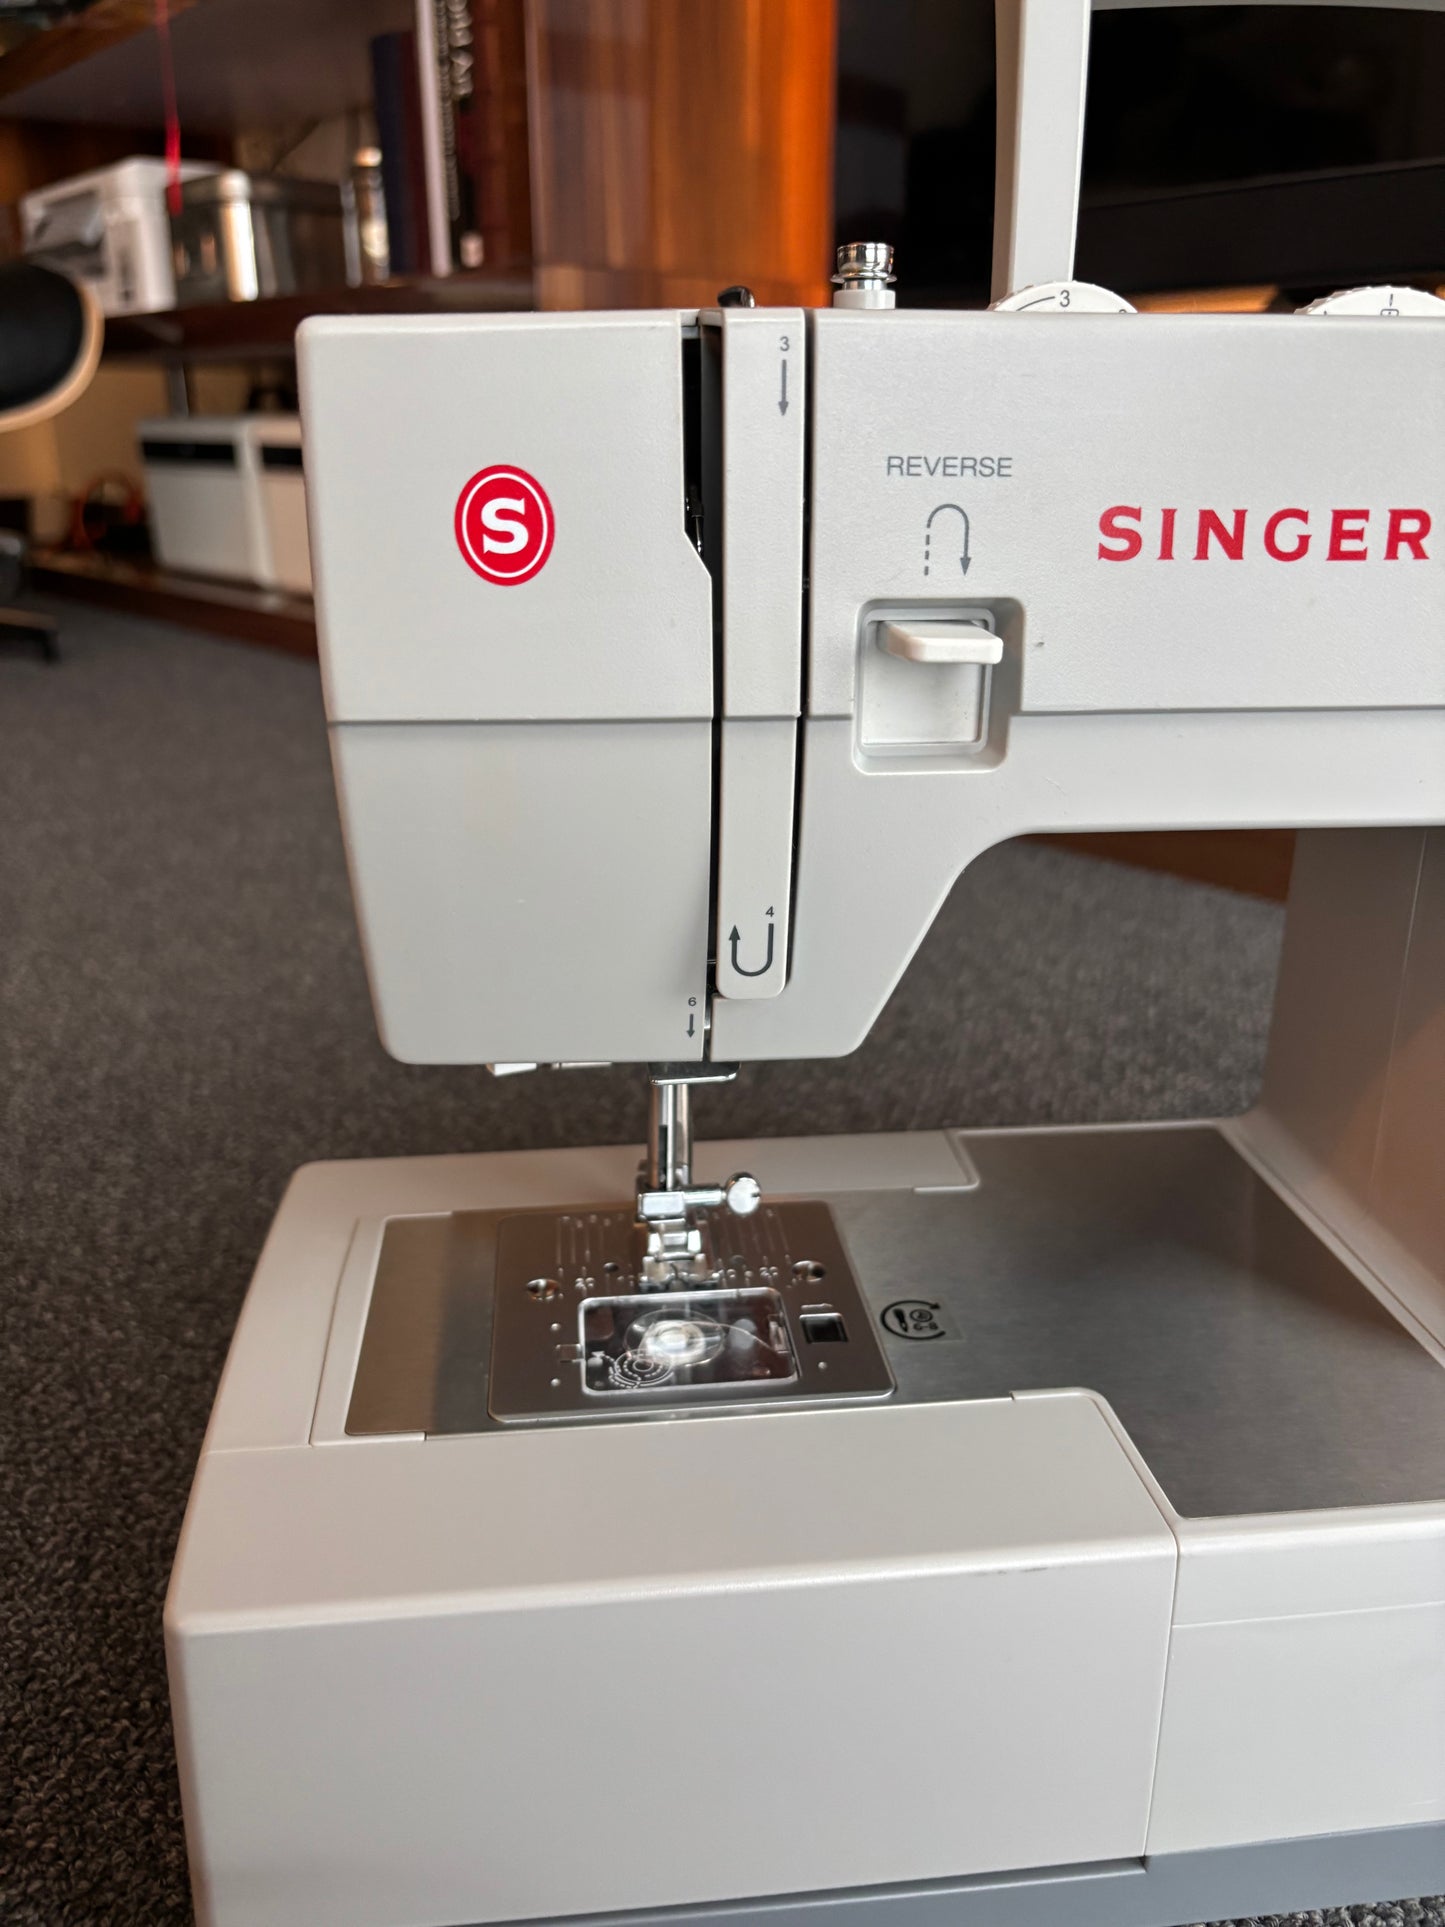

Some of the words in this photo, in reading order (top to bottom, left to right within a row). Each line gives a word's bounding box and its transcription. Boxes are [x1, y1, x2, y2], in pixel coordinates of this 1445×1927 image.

[1059, 289, 1071, 307] 3
[778, 335, 791, 352] 3
[886, 455, 1014, 478] REVERSE
[480, 497, 529, 555] S
[1097, 505, 1432, 563] SINGER
[764, 905, 775, 918] 4
[687, 996, 697, 1007] 6
